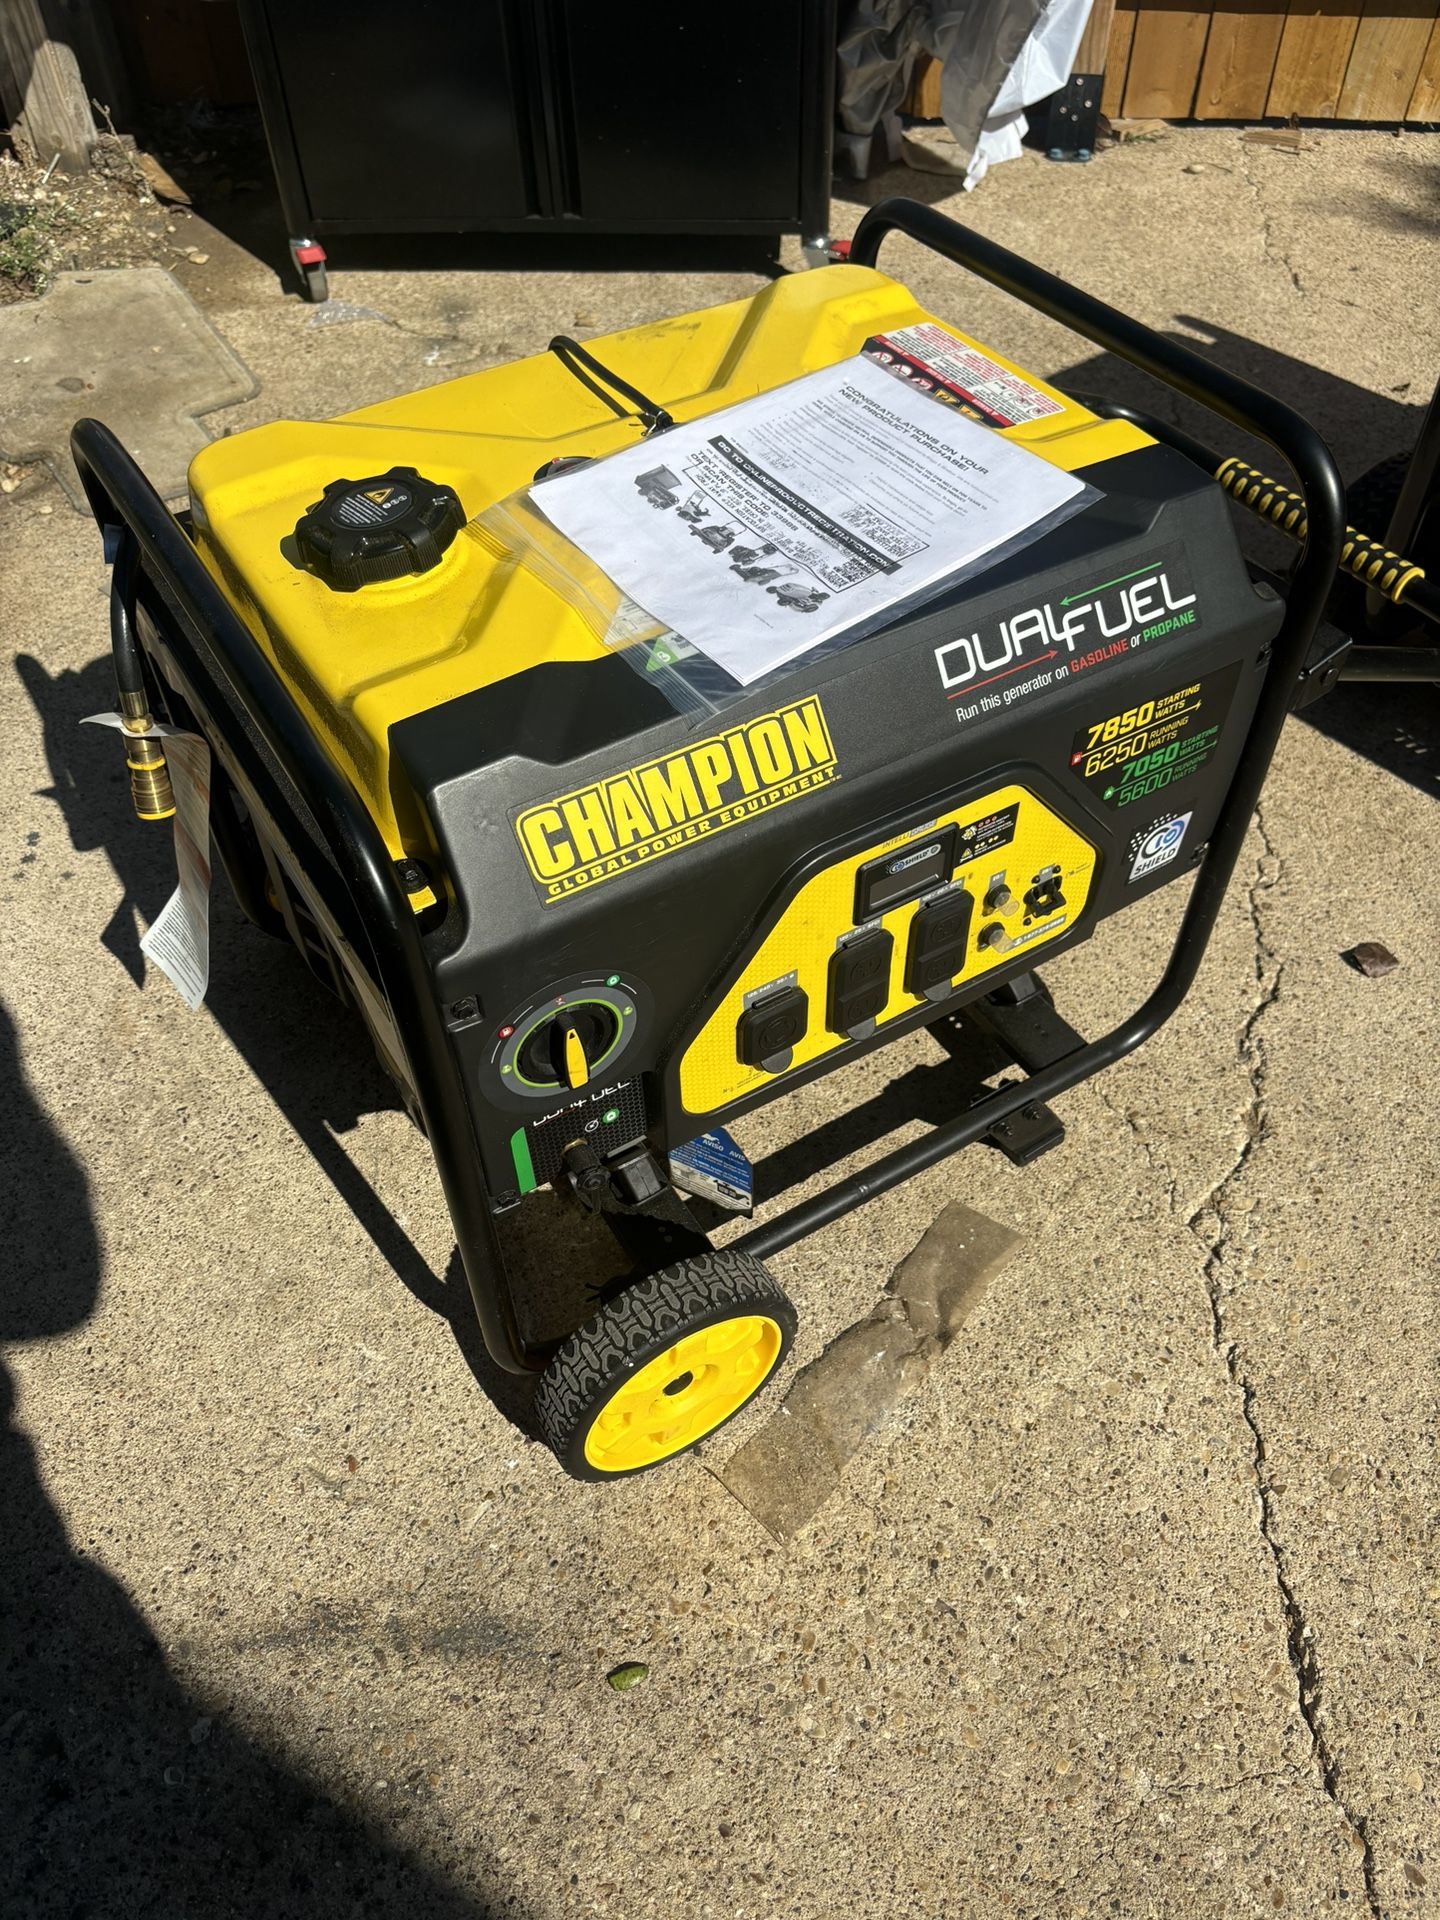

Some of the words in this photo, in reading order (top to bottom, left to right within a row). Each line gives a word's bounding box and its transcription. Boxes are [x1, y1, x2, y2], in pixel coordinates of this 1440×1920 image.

[839, 389, 862, 404] NEW
[862, 405, 909, 433] PRODUCT
[911, 434, 968, 471] PURCHASE!
[846, 386, 939, 444] CONGRATULATIONS
[940, 444, 958, 455] ON
[960, 455, 988, 474] YOUR
[718, 441, 731, 453] GO
[731, 452, 744, 463] TO
[698, 451, 718, 468] TEXT
[759, 501, 771, 511] TO
[703, 465, 726, 484] SCAN
[727, 484, 745, 499] THIS
[956, 703, 979, 723] Run
[980, 693, 1002, 717] this
[1003, 671, 1053, 704] generator
[1055, 665, 1070, 680] on
[1070, 638, 1129, 674] GASOLINE
[1130, 634, 1142, 649] or
[1143, 609, 1196, 642] PROPANE
[1155, 699, 1186, 719] WATTS
[1157, 683, 1201, 710] STARTING
[1087, 700, 1155, 750] 7850
[1148, 729, 1178, 750] WATTS
[1149, 715, 1190, 740] RUNNING
[1181, 725, 1219, 749] STARTING
[1085, 732, 1148, 777] 6250
[1120, 741, 1181, 785] 7050
[1174, 752, 1208, 774] RUNNING
[1179, 739, 1206, 757] WATTS
[1118, 767, 1173, 807] 5600
[1172, 763, 1198, 782] WATTS
[522, 702, 830, 877] CHAMPION
[547, 855, 632, 897] GLOBAL
[638, 820, 712, 859] POWER
[720, 766, 836, 825] EQUIPMENT
[1133, 847, 1177, 876] SHIELD
[702, 1139, 724, 1152] AVISO
